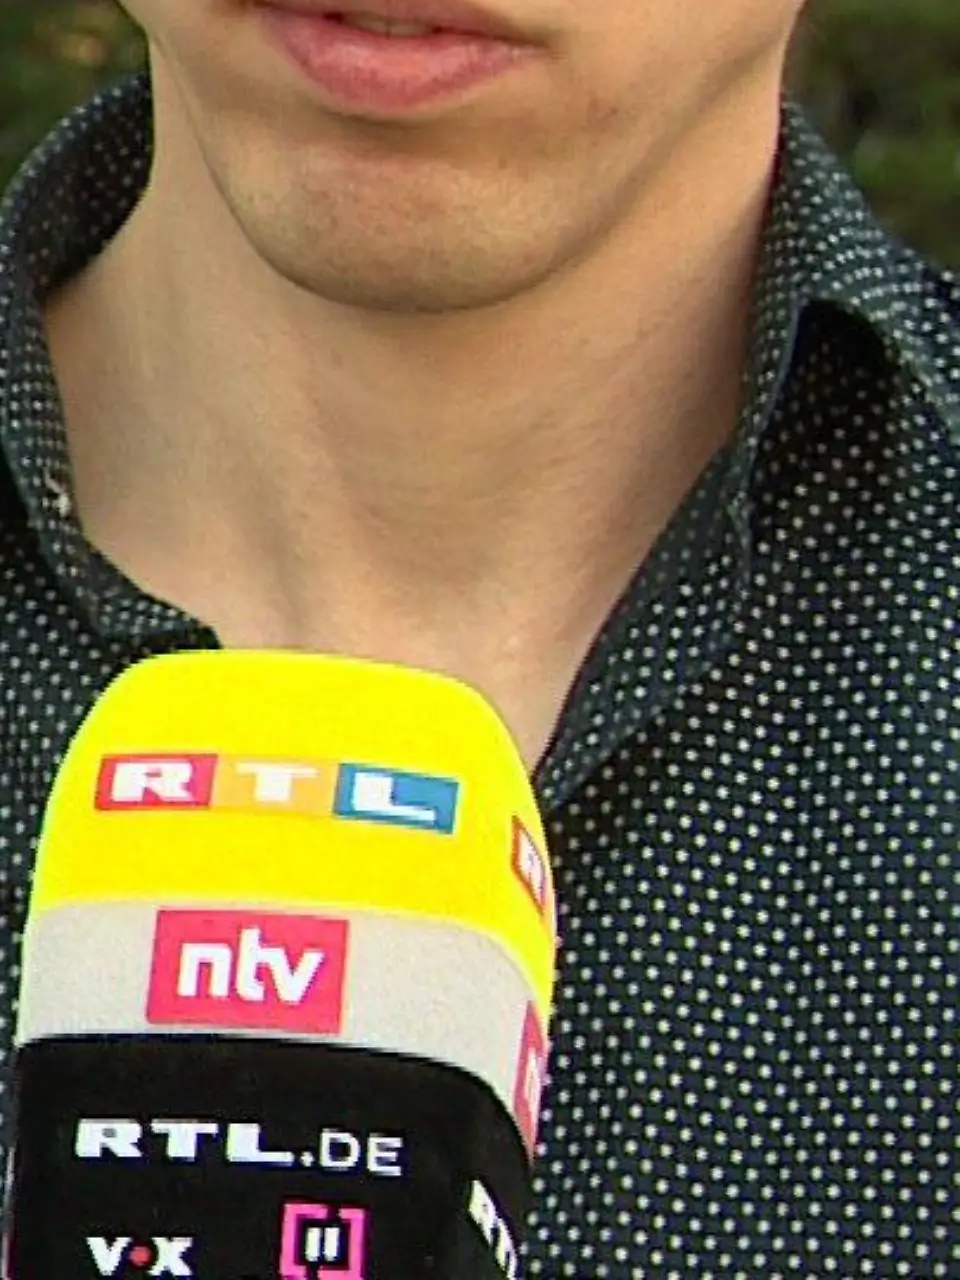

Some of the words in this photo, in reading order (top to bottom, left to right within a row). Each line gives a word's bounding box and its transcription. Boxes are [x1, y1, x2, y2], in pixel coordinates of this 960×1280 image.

[110, 760, 437, 827] RTL
[176, 924, 325, 1005] ntv
[74, 1117, 404, 1177] RTL.DE
